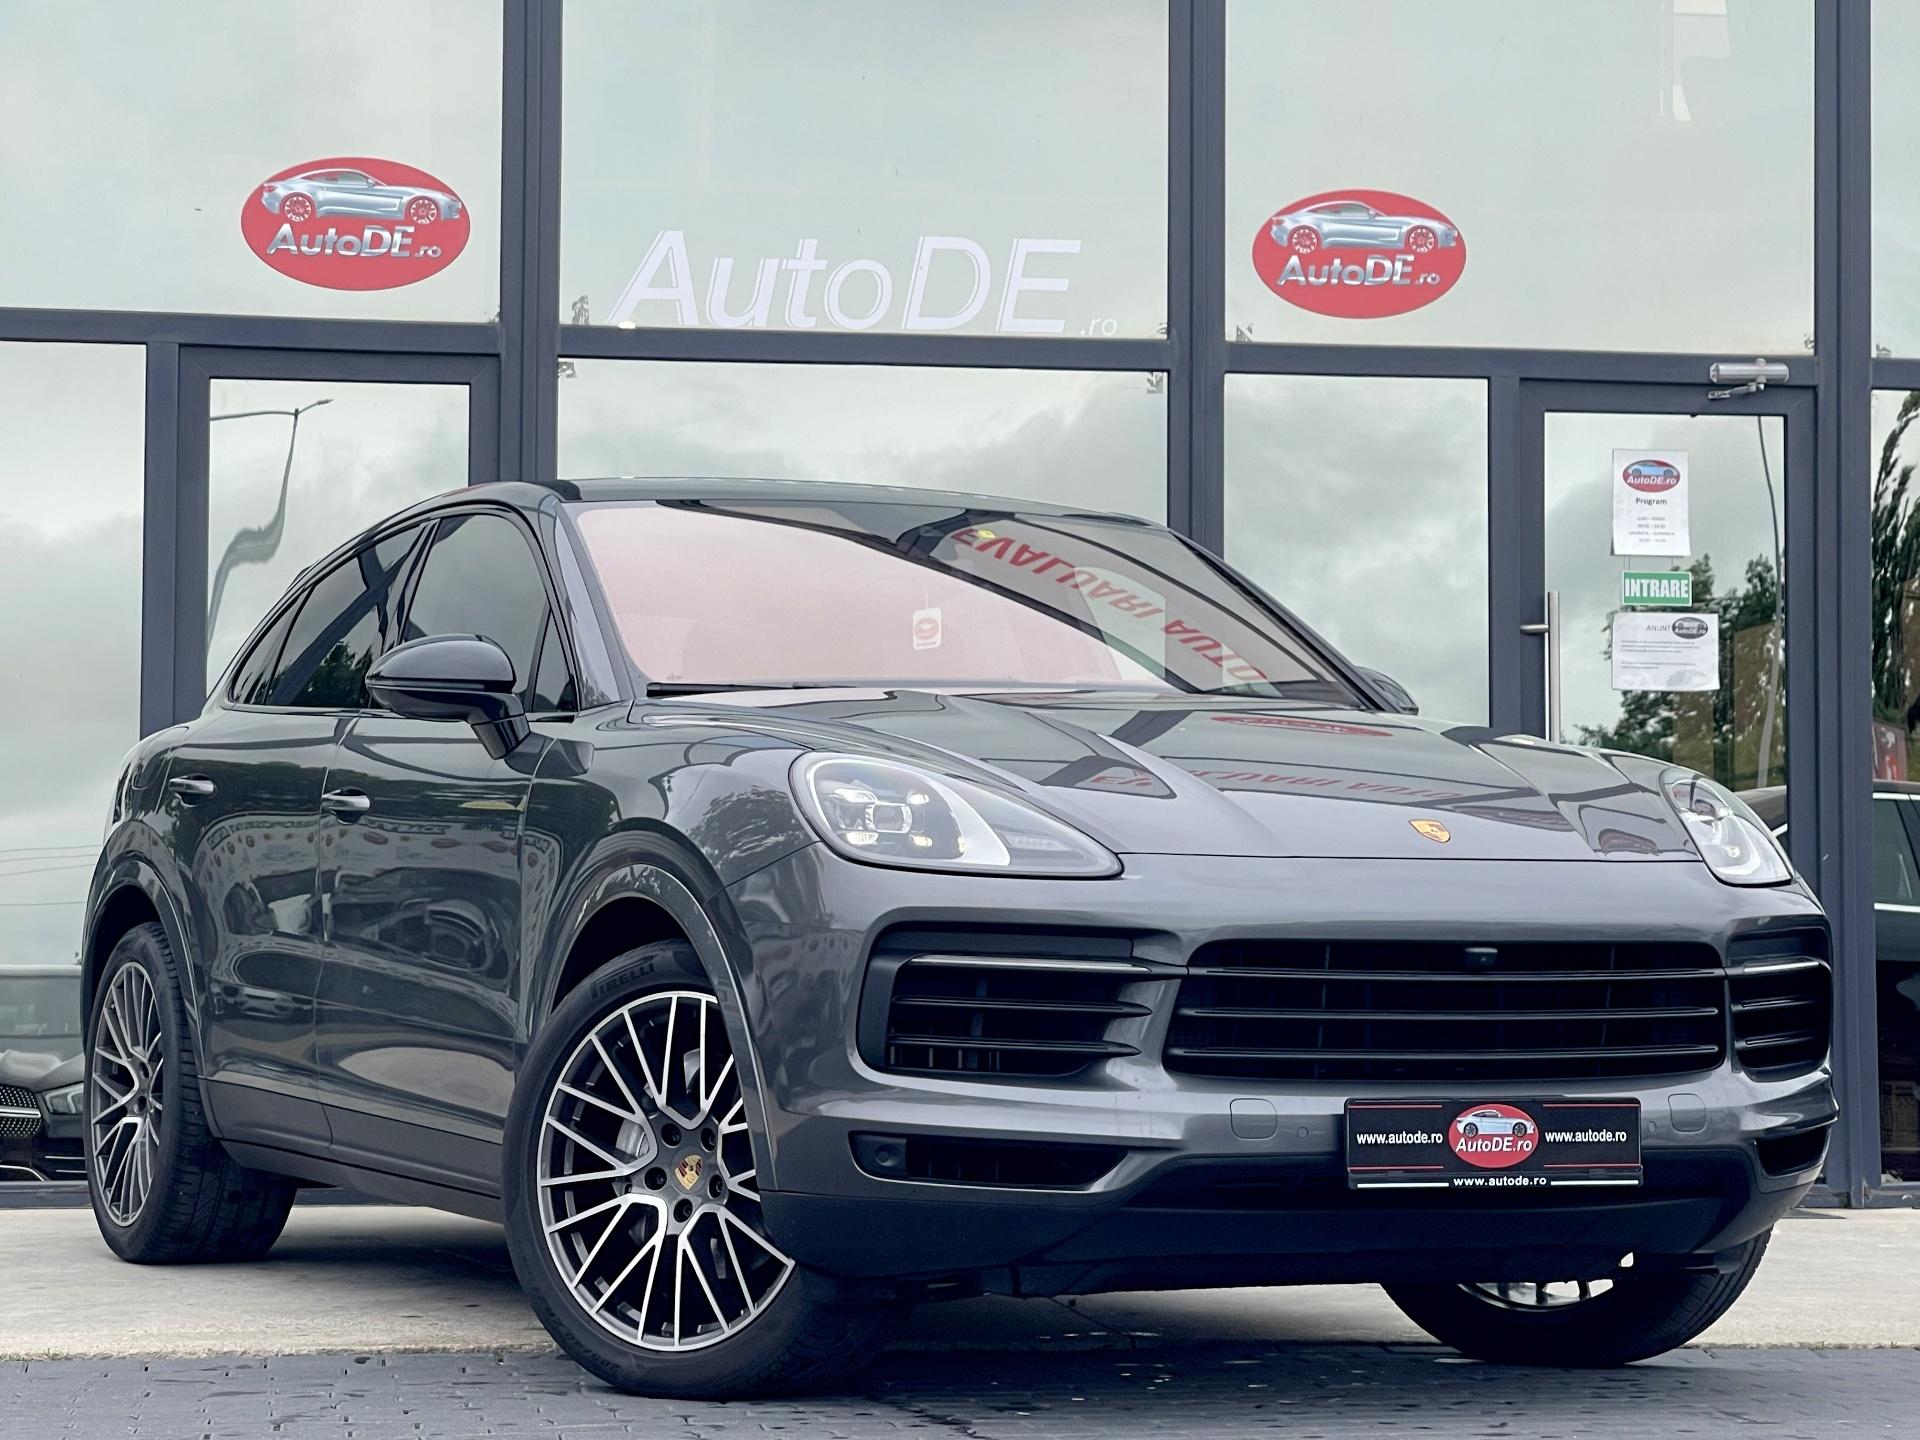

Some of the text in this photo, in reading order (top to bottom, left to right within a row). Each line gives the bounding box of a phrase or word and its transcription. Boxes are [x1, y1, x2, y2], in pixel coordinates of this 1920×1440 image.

[1635, 497, 1668, 506] Program
[1624, 578, 1689, 598] INTRARE
[1356, 1131, 1444, 1145] www.autode.ro
[1545, 1128, 1627, 1143] www.autode.ro
[1455, 1136, 1533, 1154] AutoDE.ro
[1453, 1175, 1547, 1188] www.autode.ro
